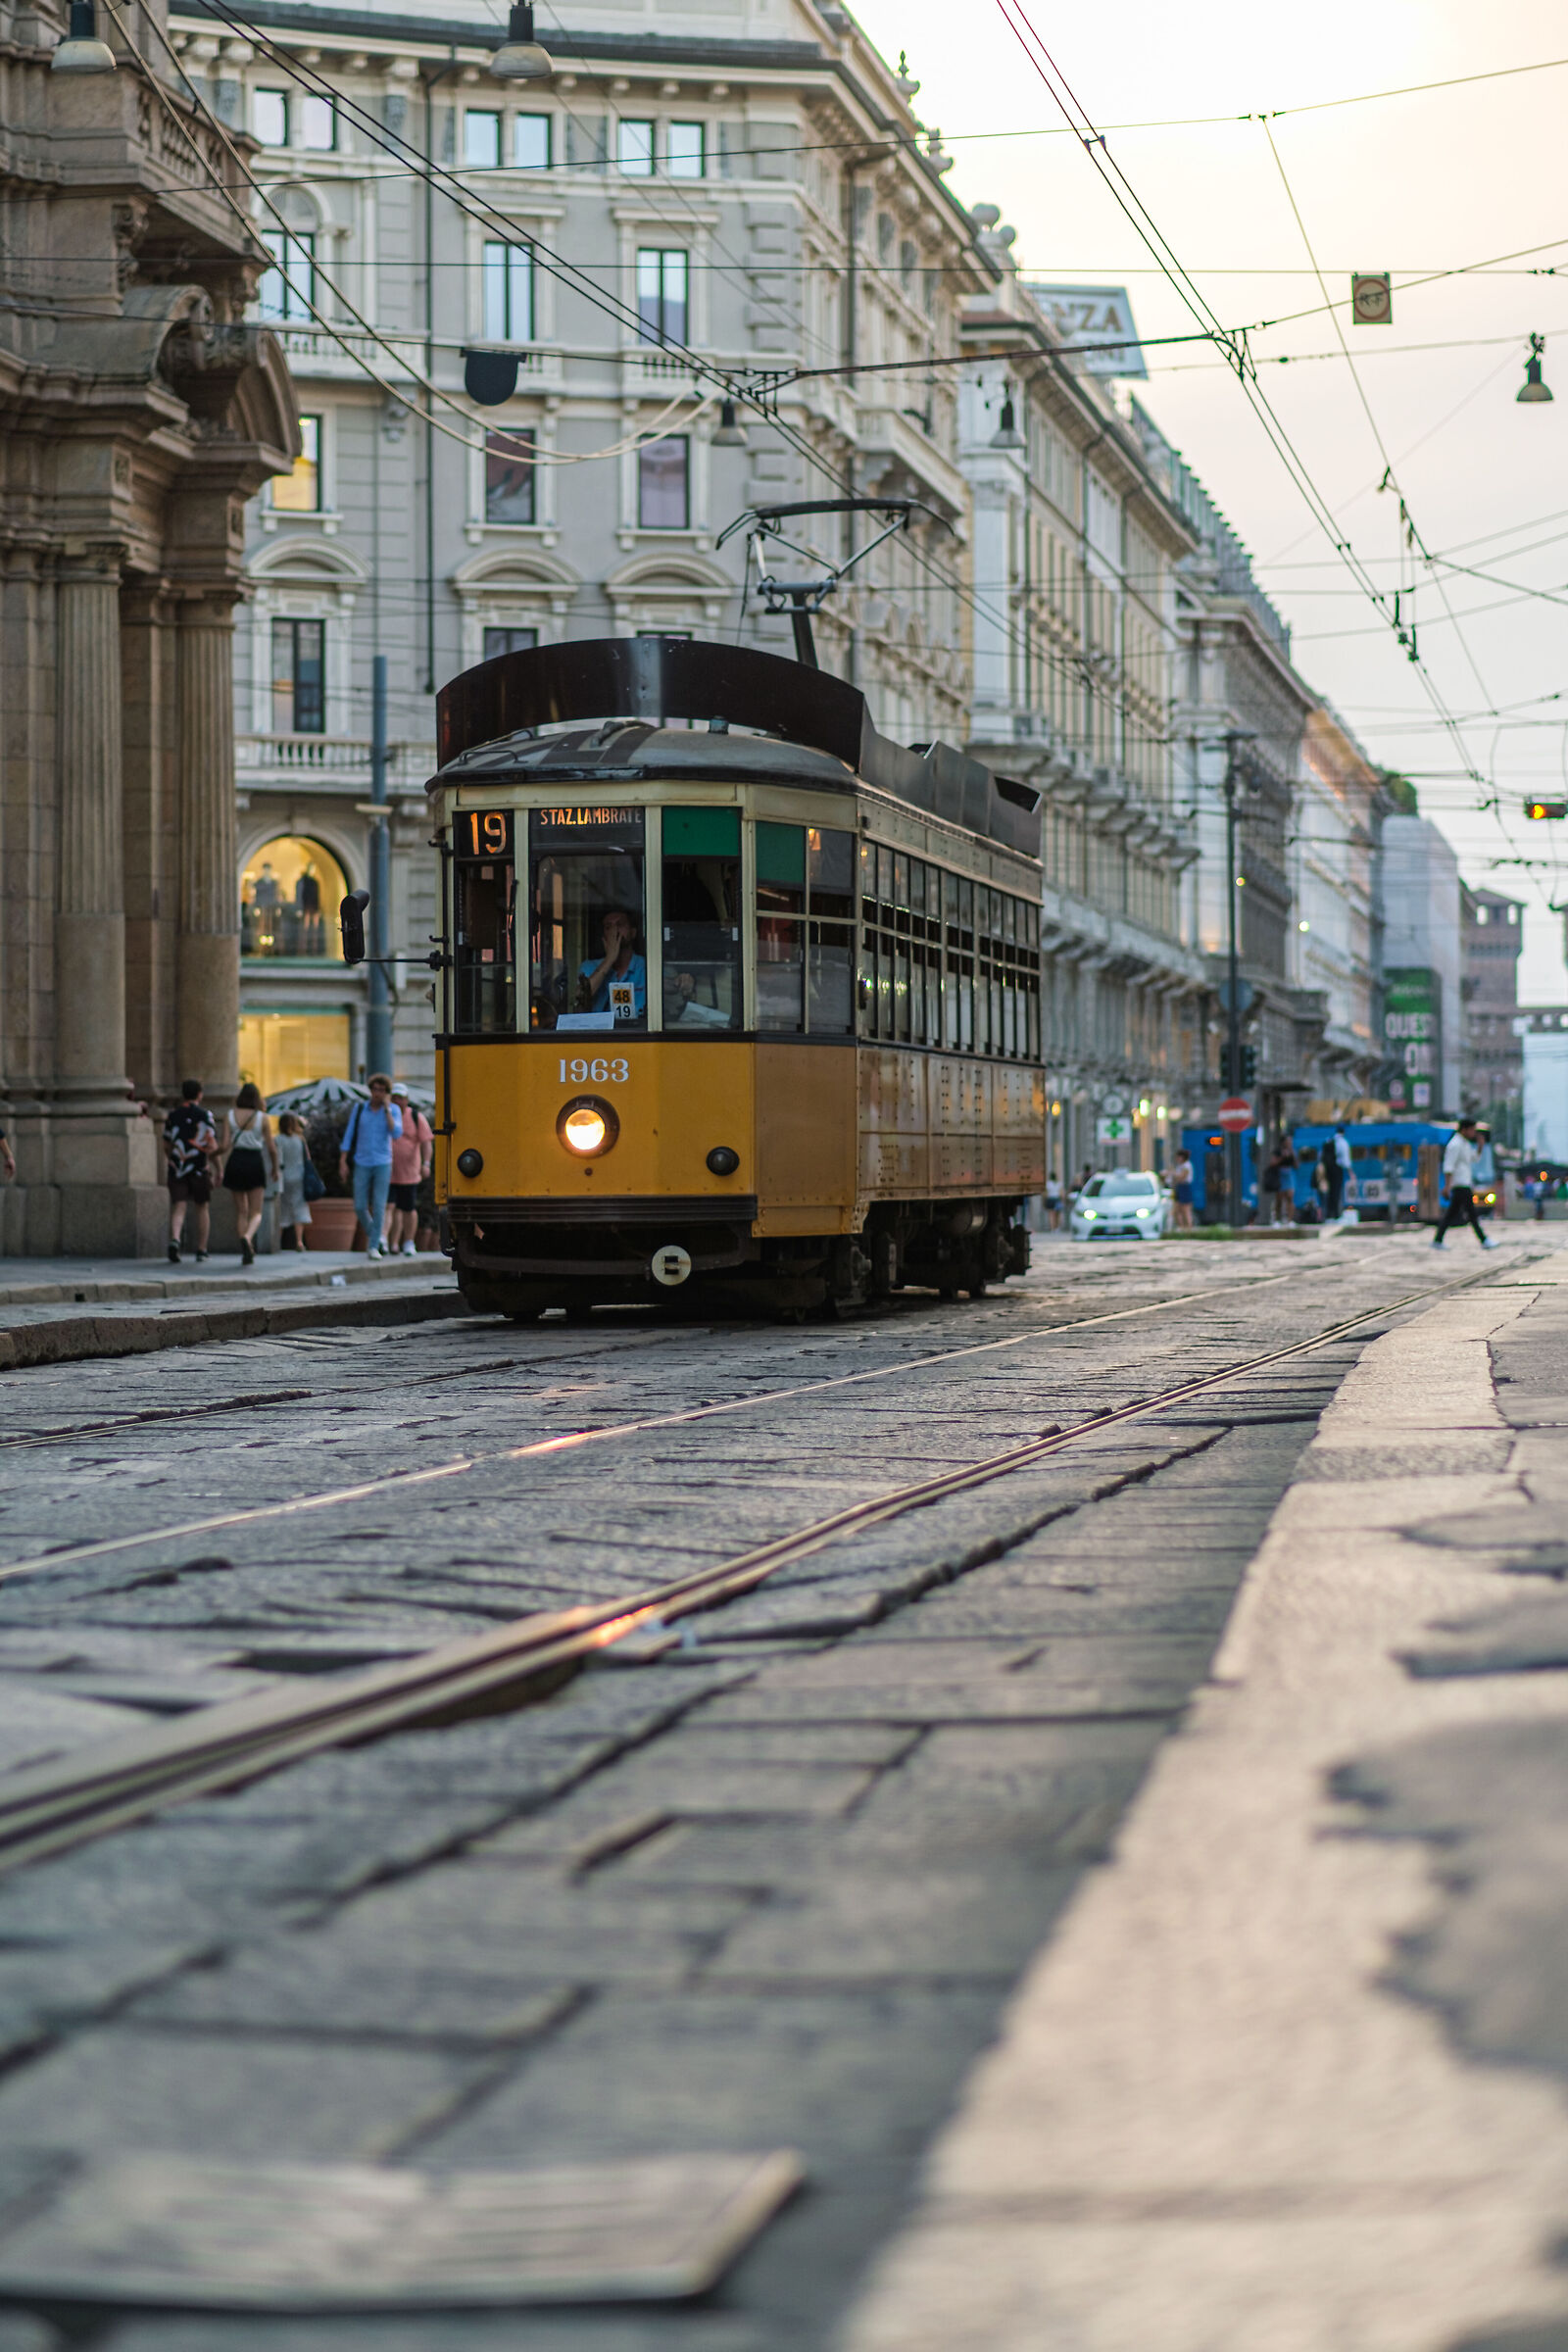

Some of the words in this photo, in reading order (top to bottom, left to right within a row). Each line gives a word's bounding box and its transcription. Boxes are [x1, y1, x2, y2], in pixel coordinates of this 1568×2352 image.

[469, 811, 507, 856] 19
[614, 990, 630, 1004] 48
[615, 1004, 631, 1018] 19
[558, 1058, 630, 1084] 1963
